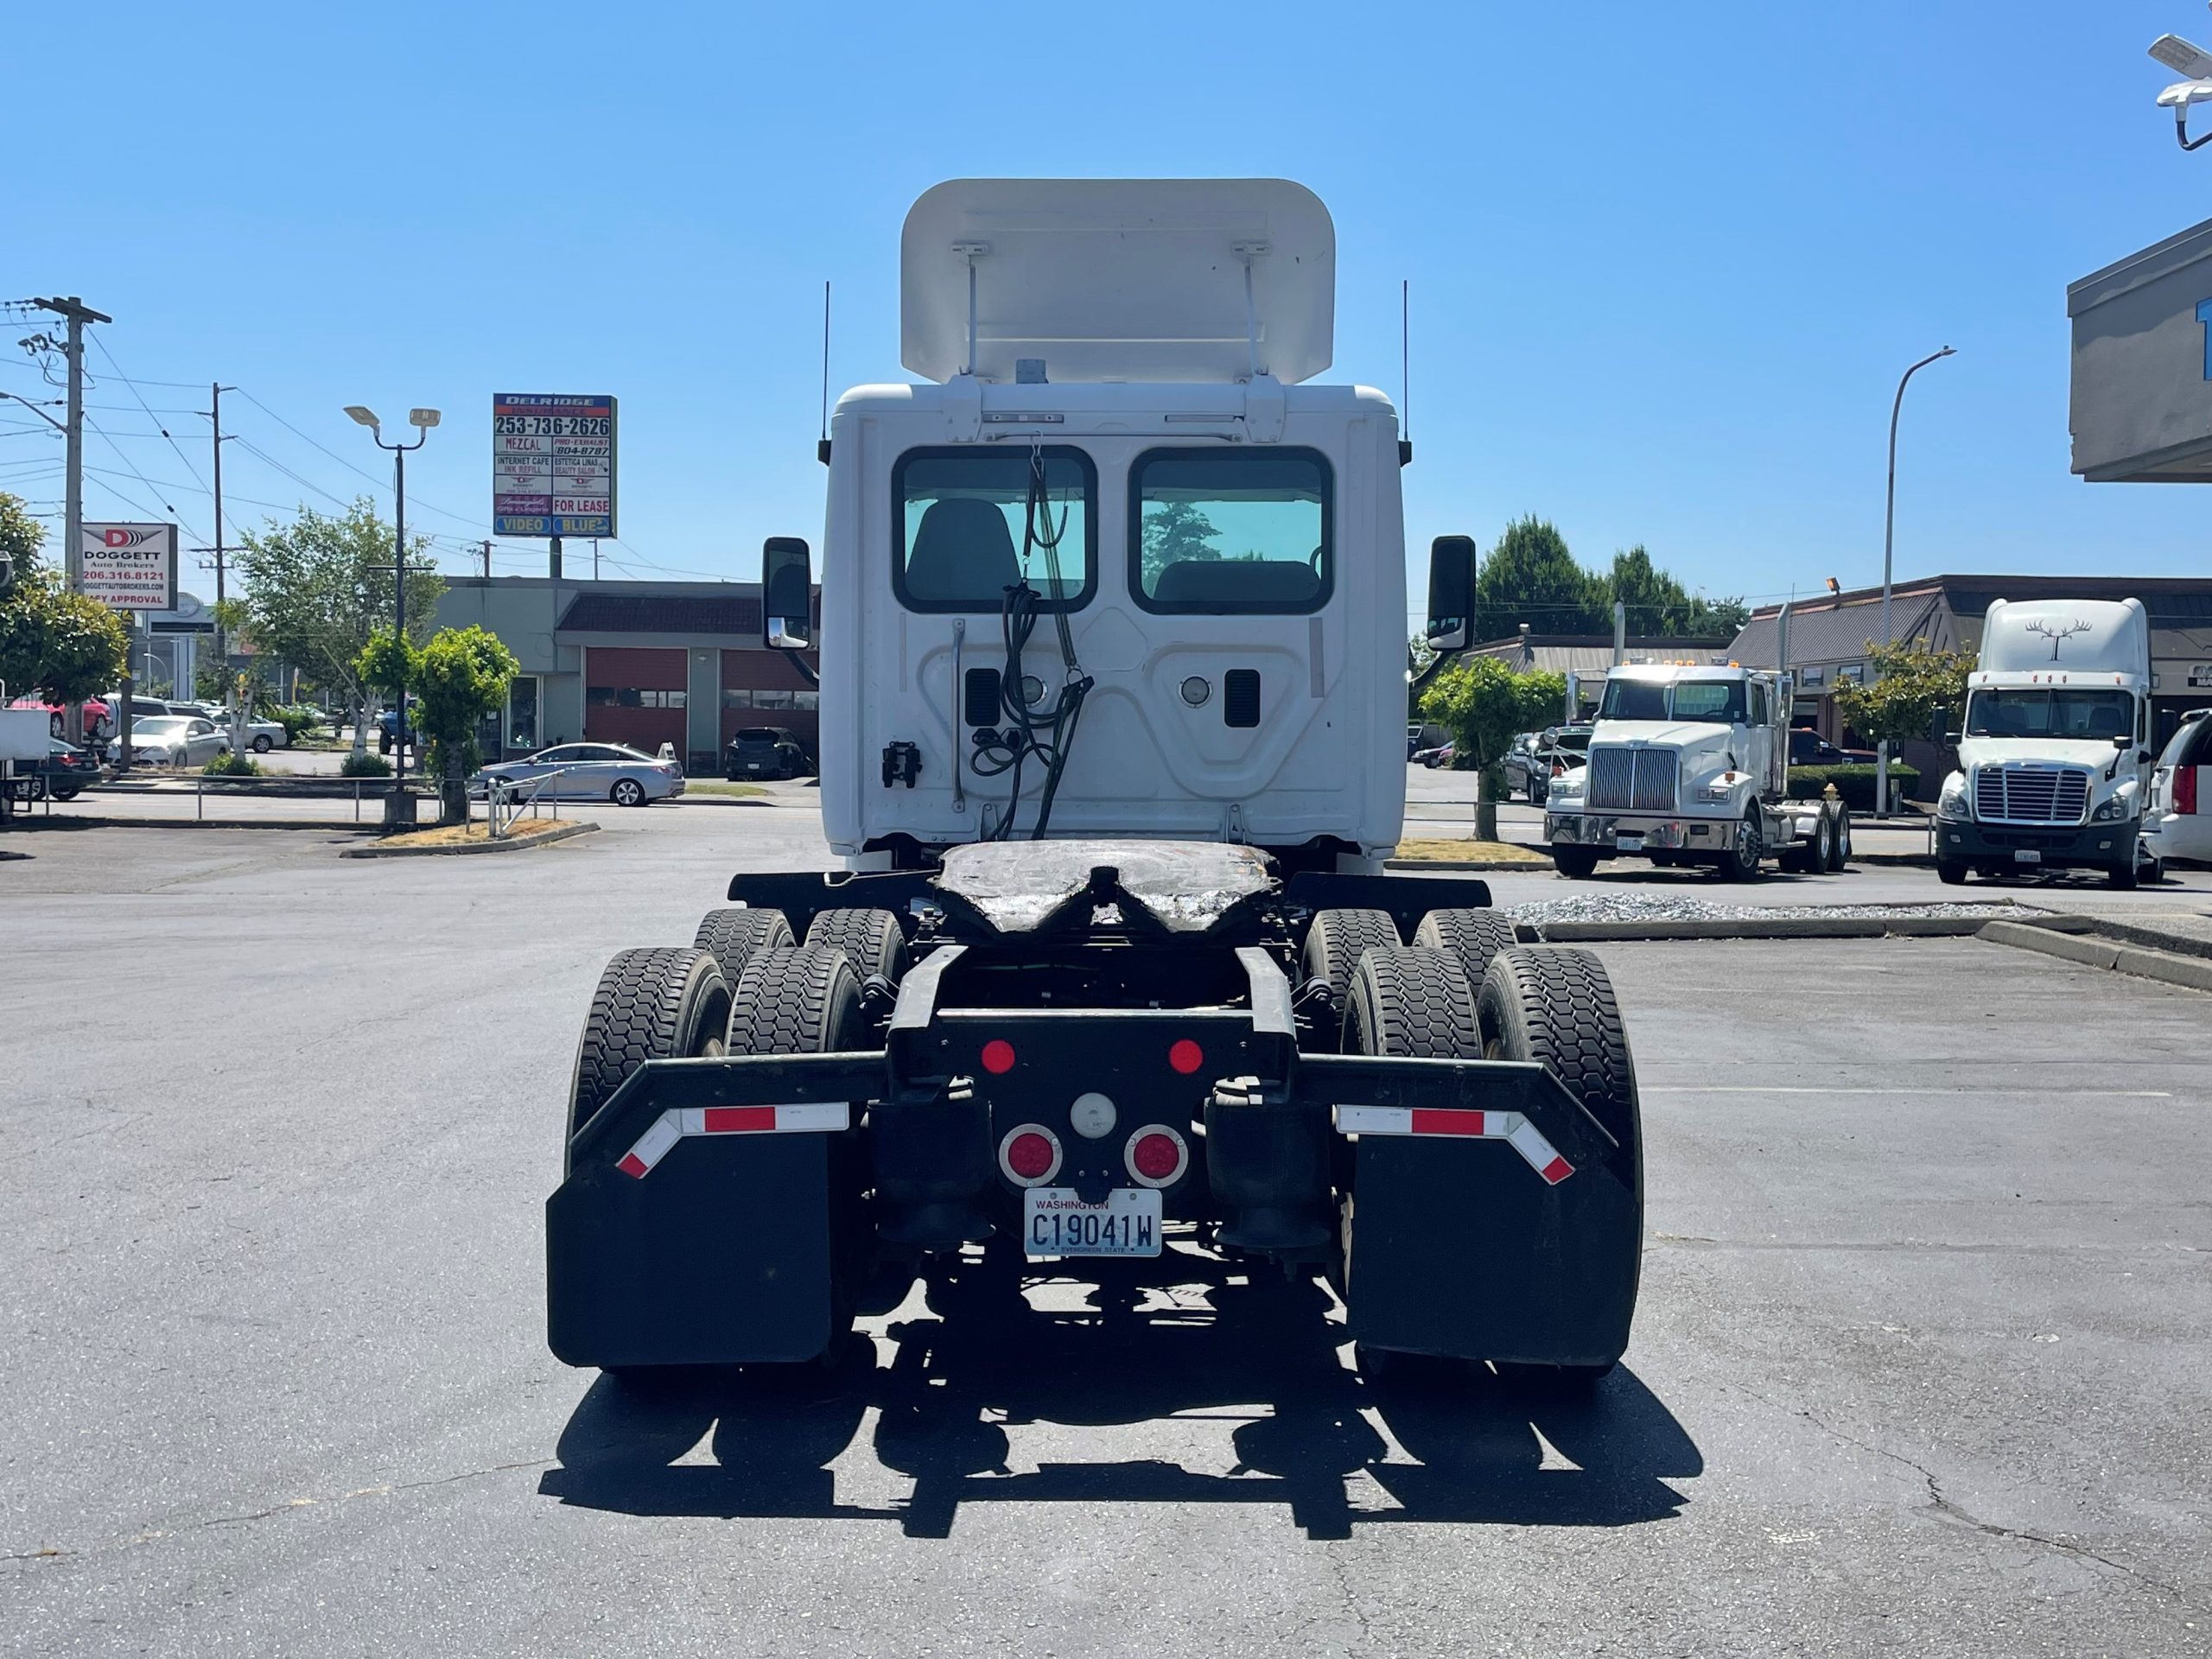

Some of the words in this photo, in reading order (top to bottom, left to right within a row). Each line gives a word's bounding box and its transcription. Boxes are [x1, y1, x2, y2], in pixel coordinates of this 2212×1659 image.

[505, 396, 594, 406] DELRIDGE
[496, 416, 609, 435] 253-736-2626
[505, 437, 541, 450] MEZCAL
[497, 456, 531, 466] INTERNET
[532, 457, 550, 466] CAFE
[555, 457, 581, 467] ESTETICA
[518, 466, 542, 474] REFILL
[554, 499, 575, 512] FOR
[577, 500, 609, 512] LEASE
[504, 518, 543, 531] VIDEO
[84, 551, 161, 560] DOGGETT
[83, 571, 164, 580] 206.316.8121
[111, 594, 162, 603] APPROVAL
[1033, 1213, 1152, 1247] C19041W
